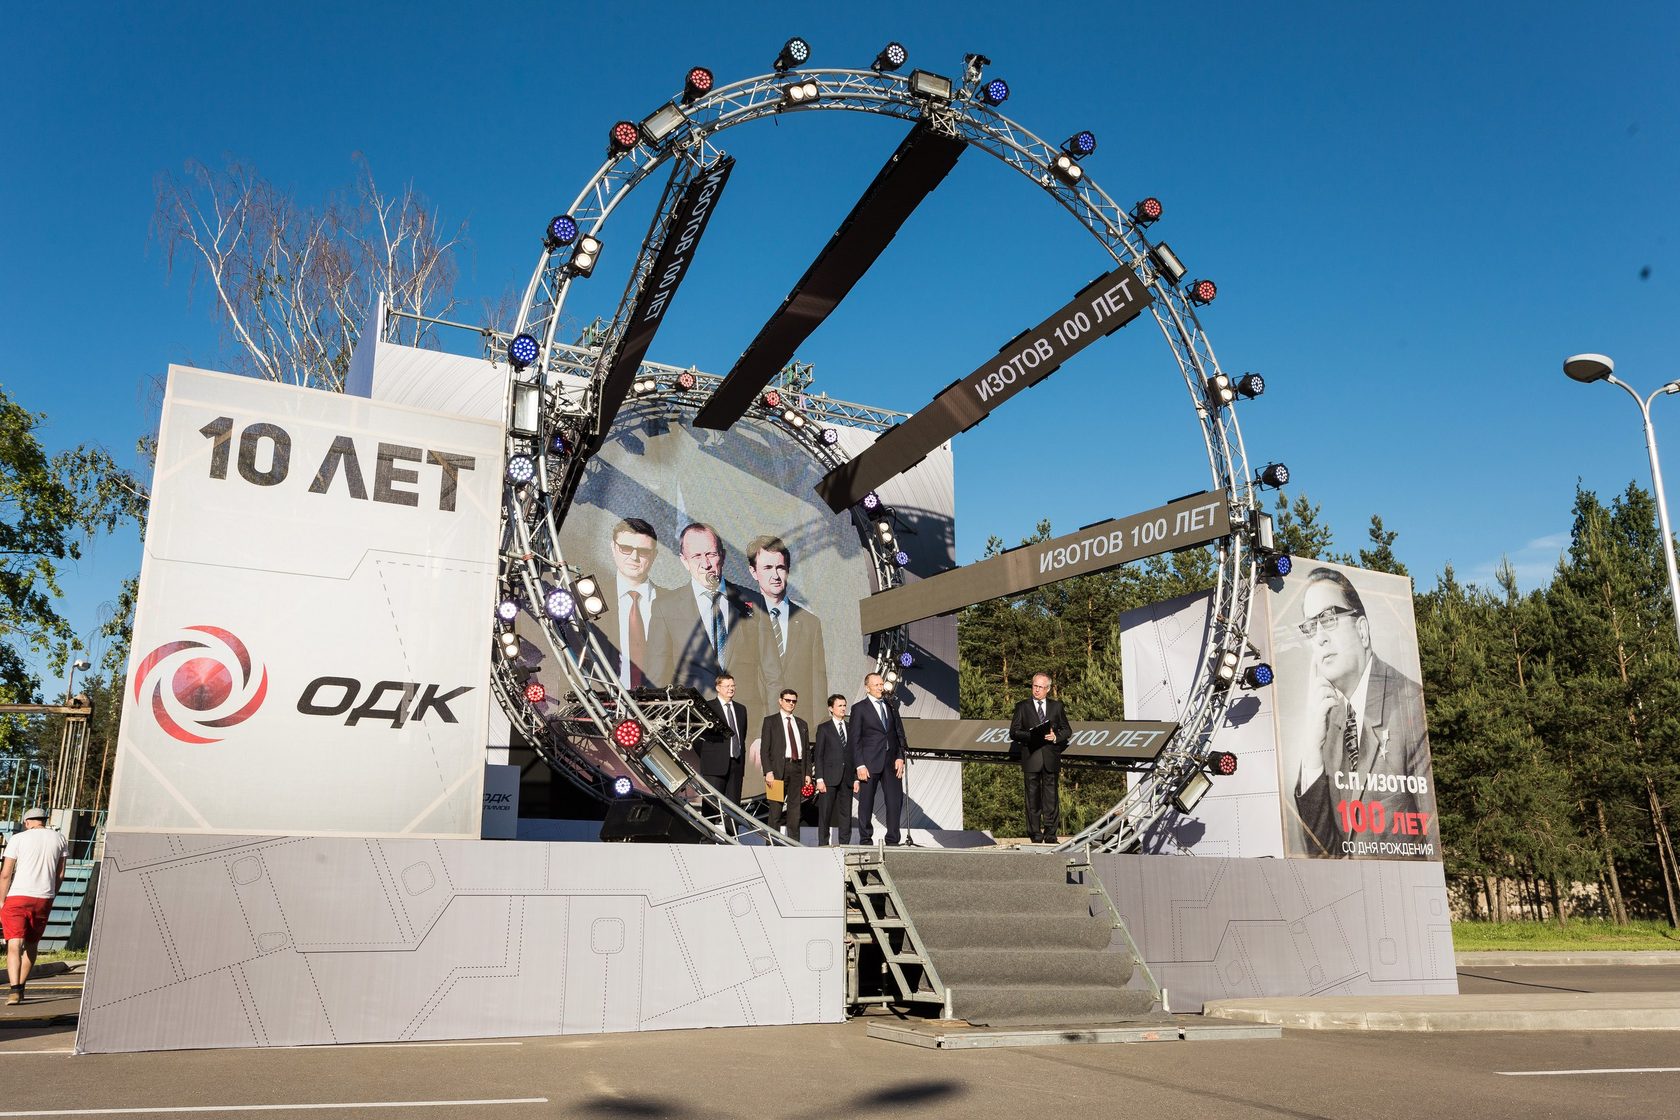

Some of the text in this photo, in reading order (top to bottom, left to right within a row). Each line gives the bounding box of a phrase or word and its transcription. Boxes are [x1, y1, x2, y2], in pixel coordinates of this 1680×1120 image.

[643, 167, 726, 322] ИЗОТОВ 100 ЛЕТ
[974, 277, 1135, 402] ИЗОТОВ 100 ЛЕТ
[198, 416, 476, 513] 10 ЛЕТ
[1039, 501, 1221, 574] ИЗОТОВ 100 ЛЕТ
[296, 675, 477, 730] ОДК
[1068, 729, 1110, 747] 100
[1107, 730, 1165, 748] ЛЕТ
[1334, 771, 1428, 794] С.П. ИЗОТОВ
[1337, 800, 1430, 836] 100 ЛЕТ
[1342, 841, 1434, 856] СО ДНЯ РОЖДЕНИЯ
